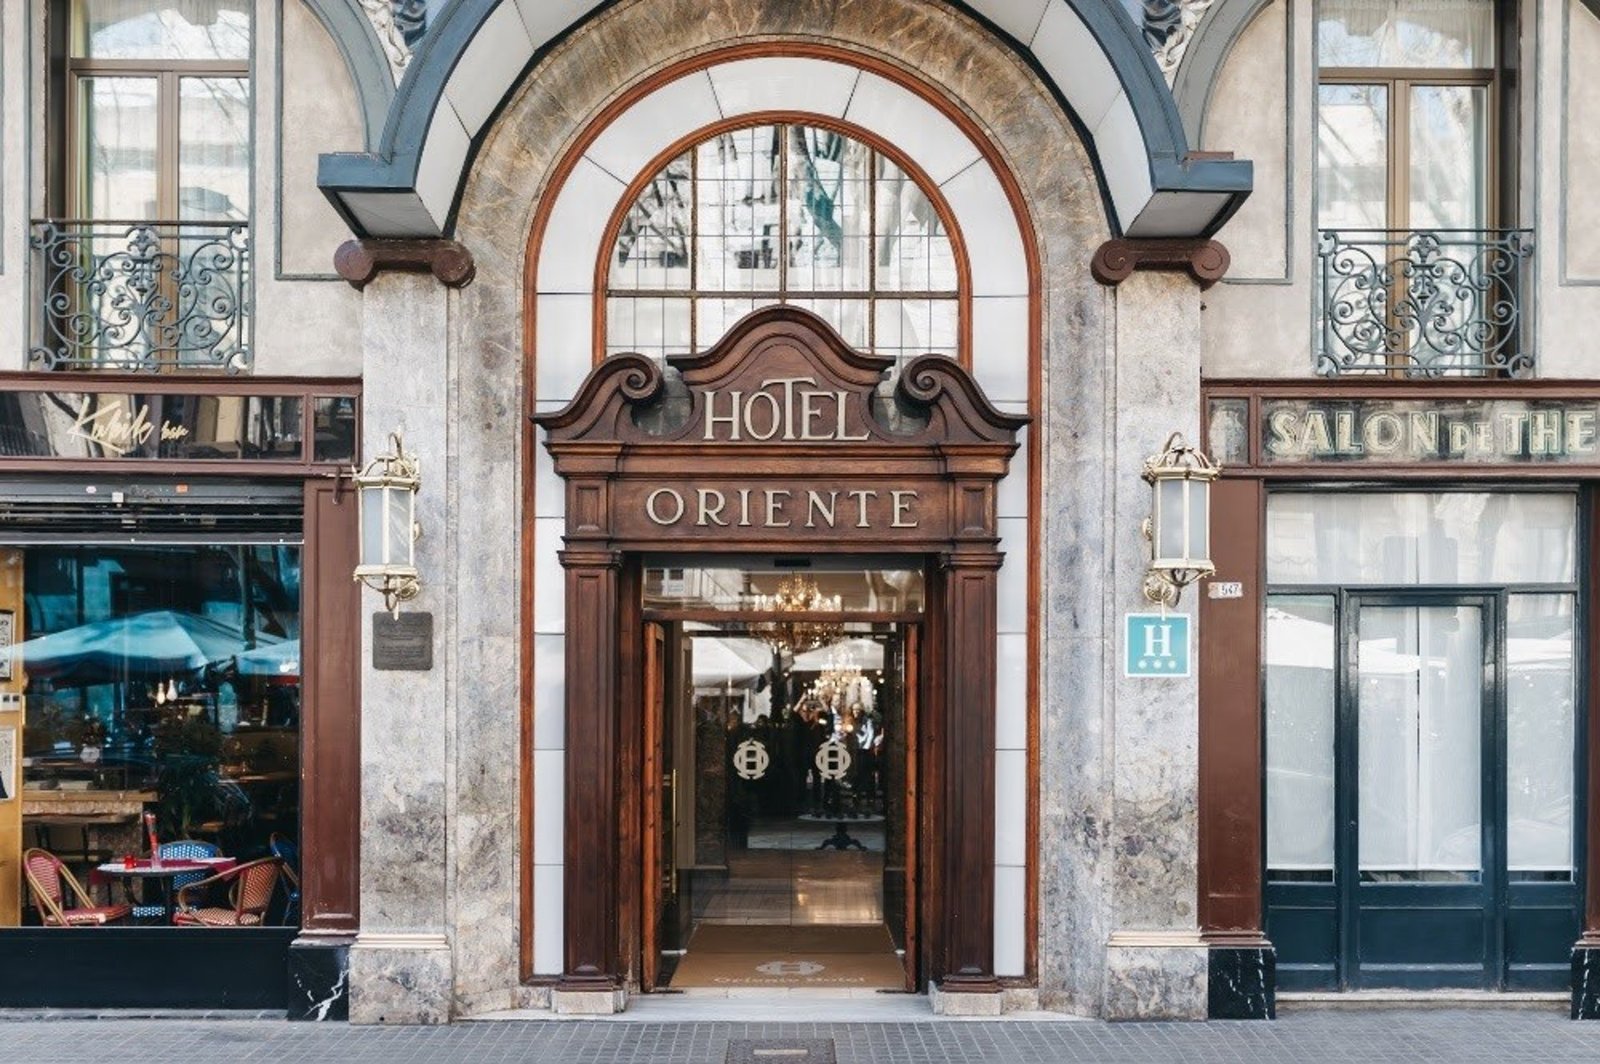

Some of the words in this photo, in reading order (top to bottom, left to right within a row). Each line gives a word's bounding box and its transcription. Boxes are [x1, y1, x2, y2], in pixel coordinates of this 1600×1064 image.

[703, 377, 870, 441] HOTEL
[1264, 410, 1439, 455] SALON
[1449, 422, 1494, 454] DE
[1498, 410, 1597, 455] THE
[646, 488, 919, 528] ORIENTE
[1143, 624, 1172, 657] H
